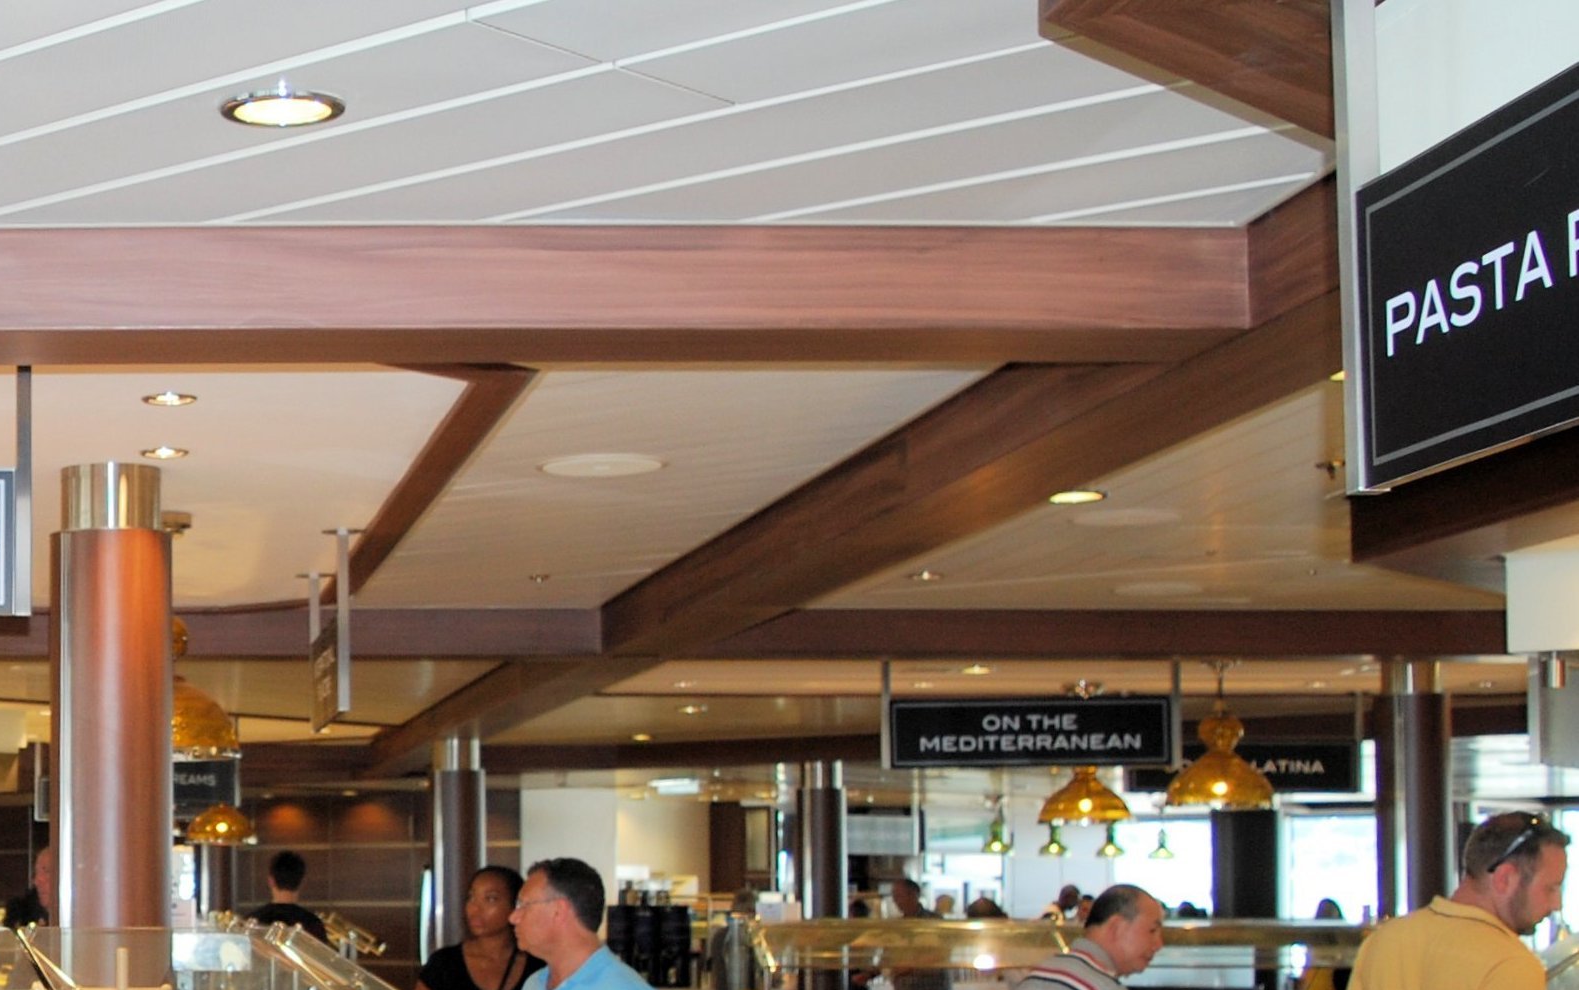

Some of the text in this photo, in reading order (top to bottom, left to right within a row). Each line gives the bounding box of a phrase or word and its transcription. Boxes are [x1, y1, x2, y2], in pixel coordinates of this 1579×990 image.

[1385, 230, 1554, 358] PASTA
[981, 713, 1079, 731] ON THE
[919, 733, 1142, 753] MEDITERRANEAN
